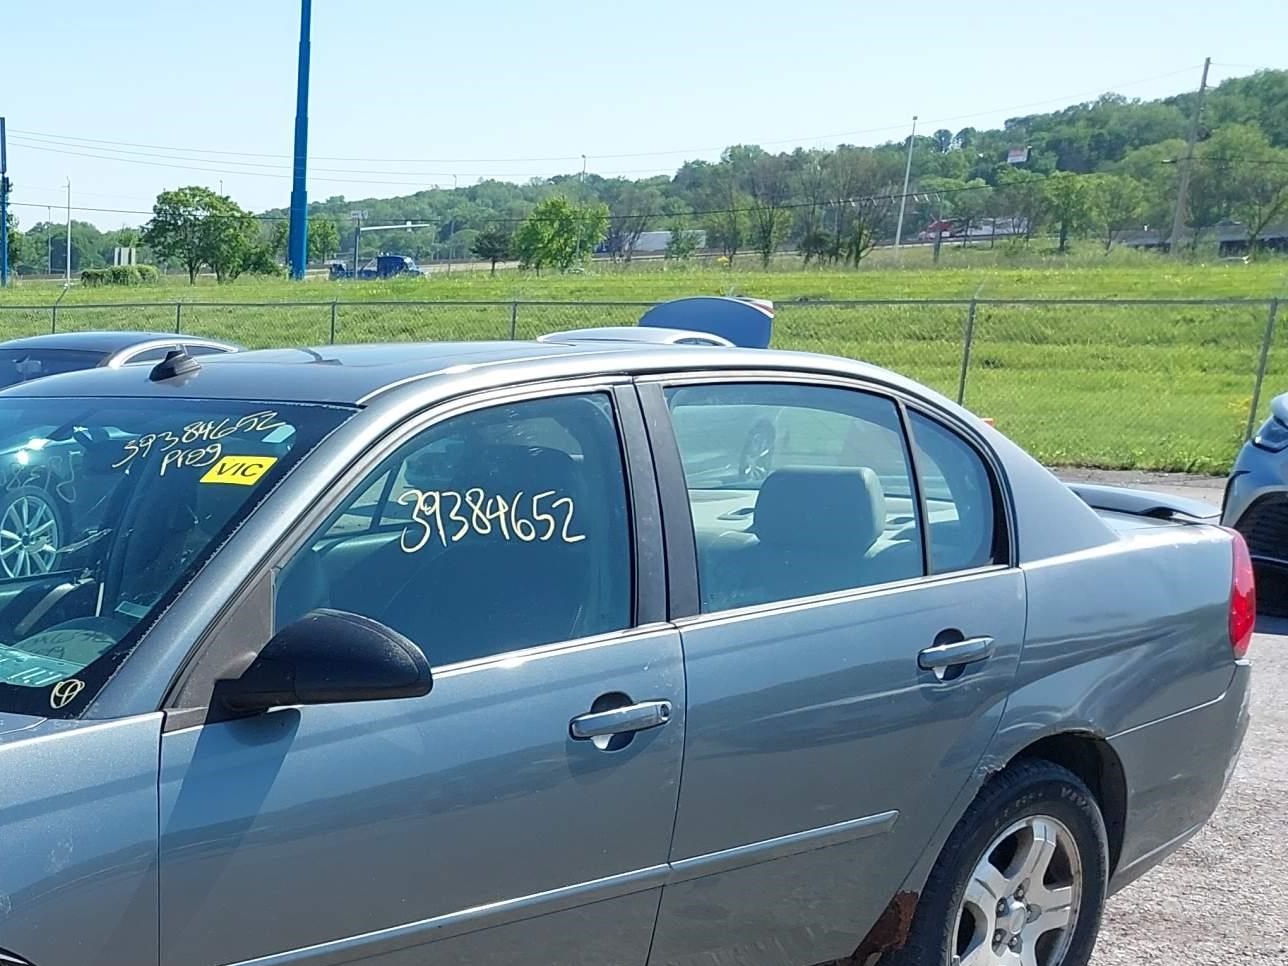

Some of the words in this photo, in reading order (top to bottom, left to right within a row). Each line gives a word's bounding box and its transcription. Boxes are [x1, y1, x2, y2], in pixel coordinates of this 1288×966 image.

[112, 410, 286, 468] 39384652
[216, 462, 264, 478] VIC
[397, 487, 586, 553] 39384652
